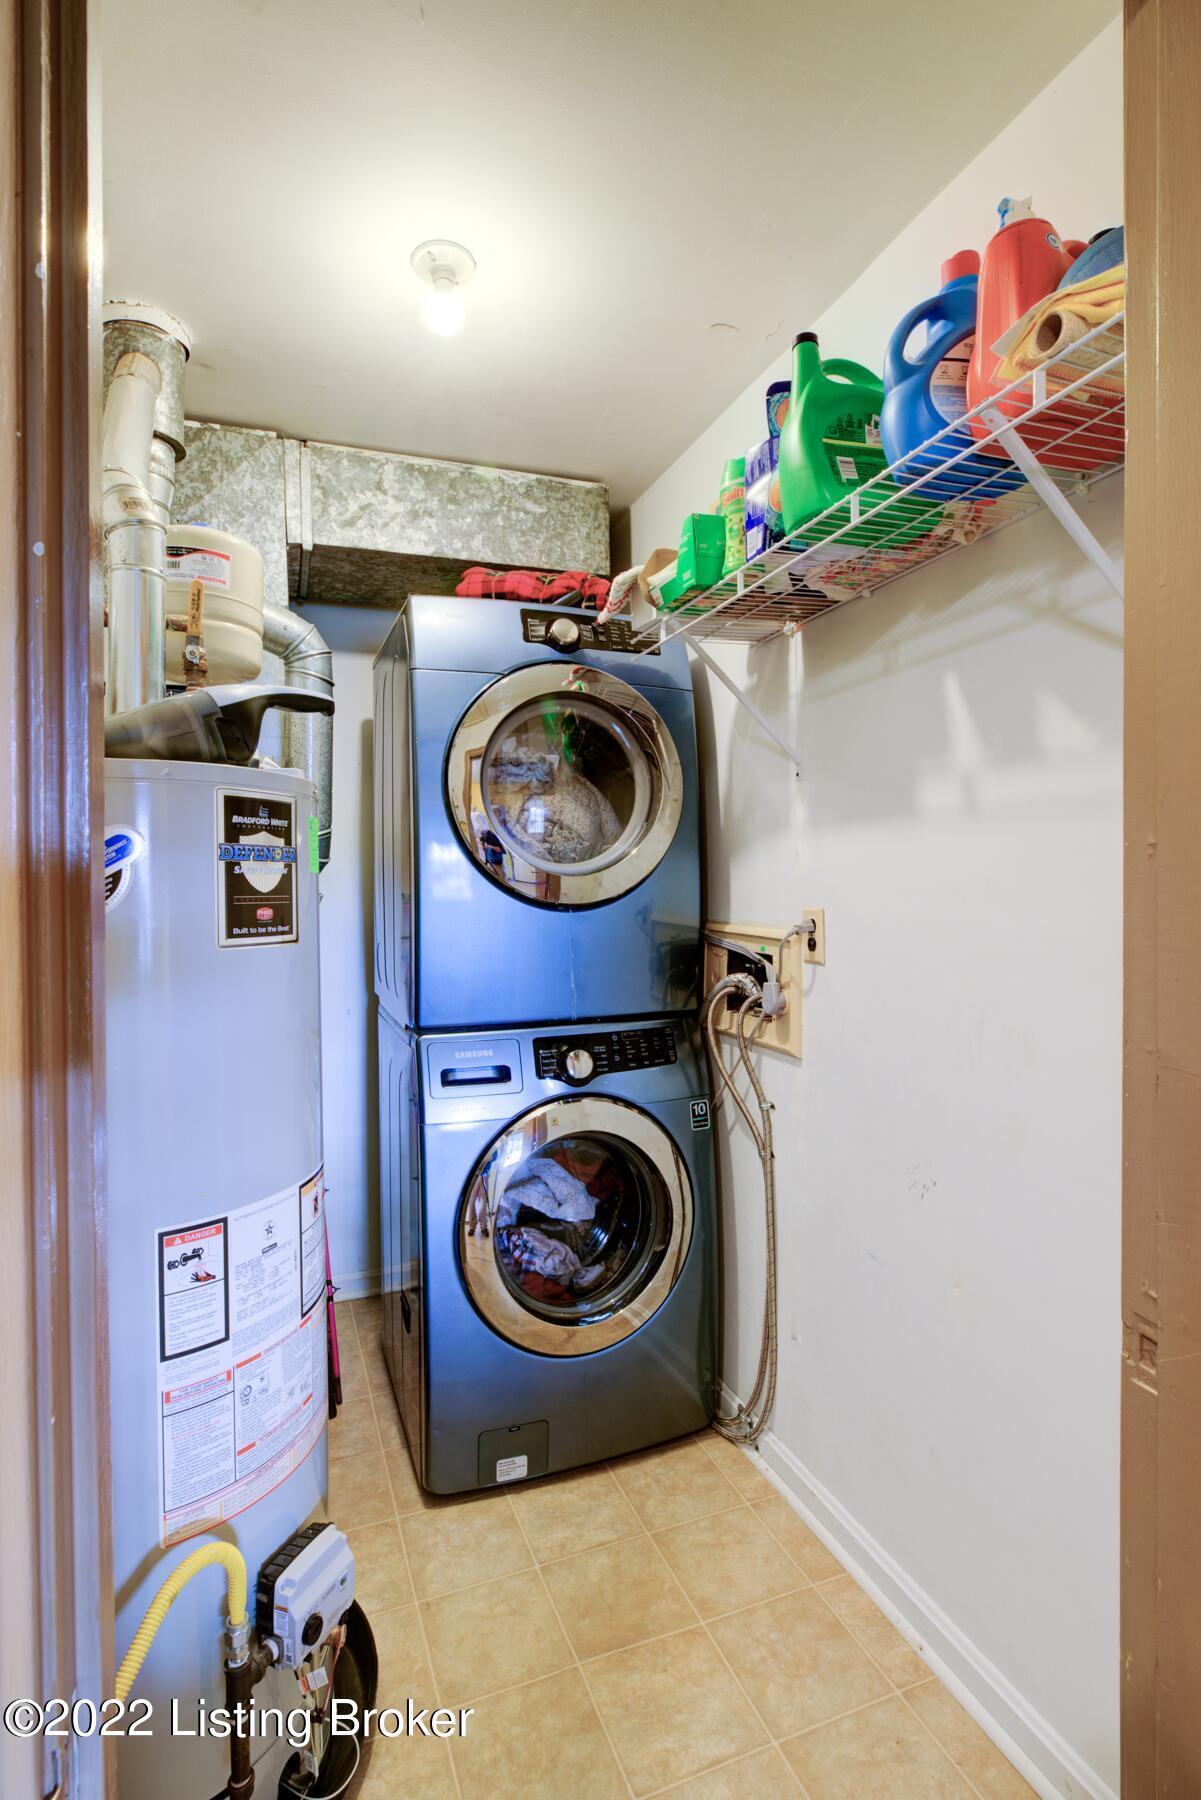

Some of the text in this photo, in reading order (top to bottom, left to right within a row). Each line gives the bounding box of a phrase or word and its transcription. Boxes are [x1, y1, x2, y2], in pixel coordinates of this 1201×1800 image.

[722, 487, 745, 508] Gain
[232, 815, 288, 827] BRADFORD WHITE
[219, 844, 297, 863] DEFENDER
[233, 927, 249, 935] Built
[454, 1048, 494, 1059] SAMSUNG
[692, 1103, 706, 1115] 10
[185, 1228, 216, 1242] DANGER
